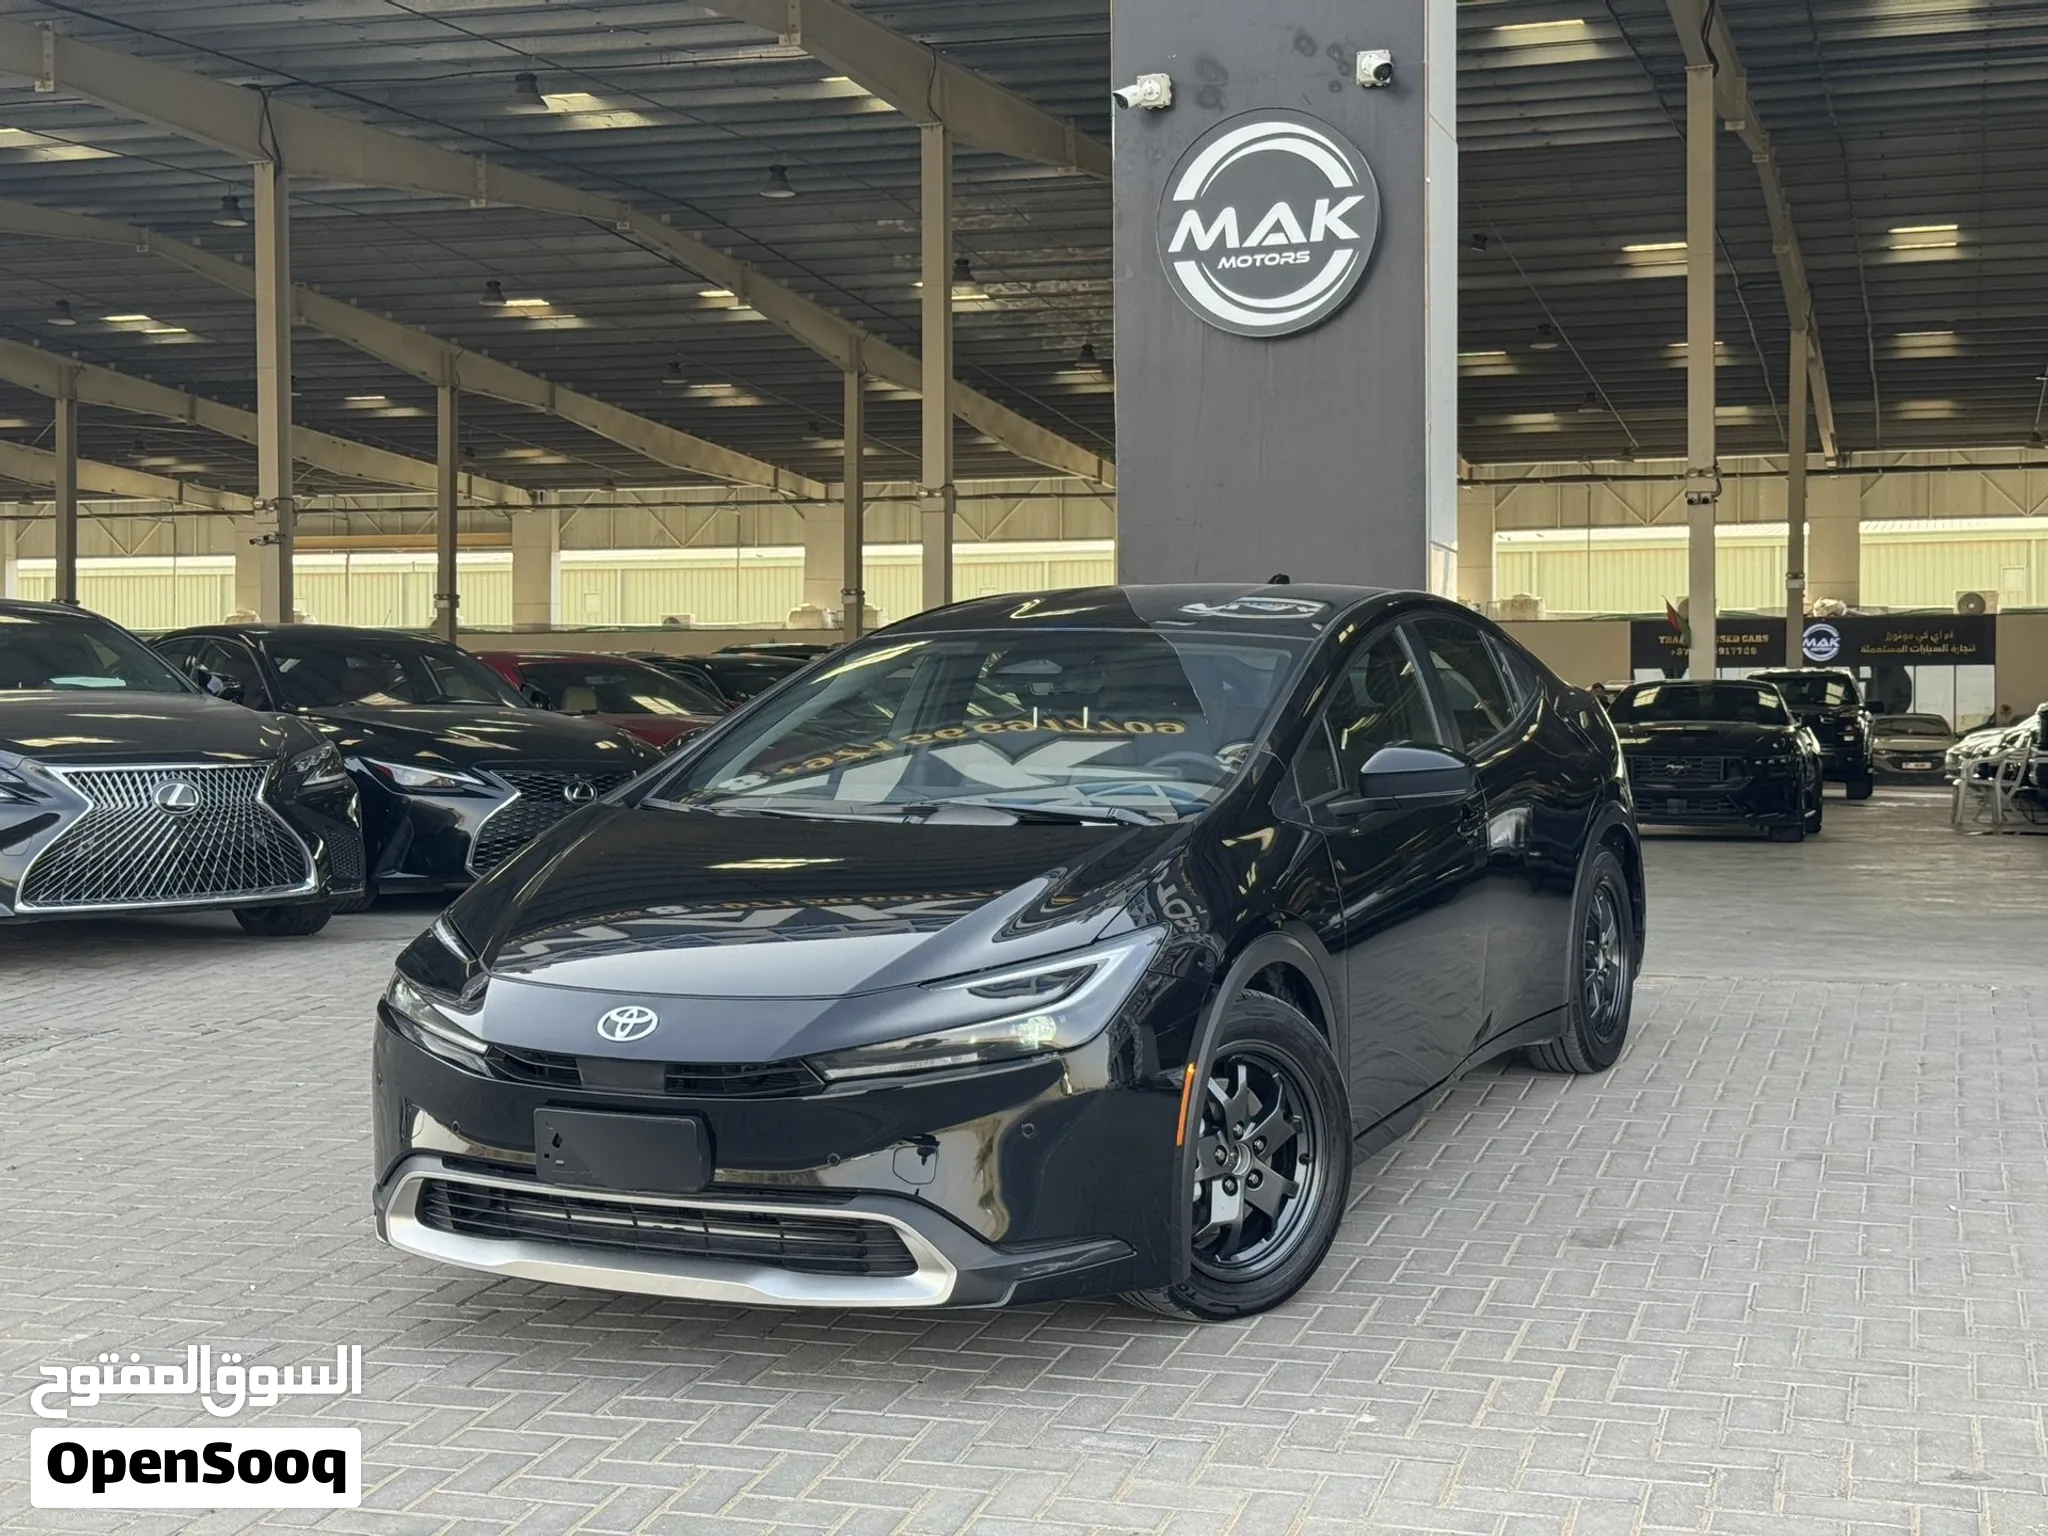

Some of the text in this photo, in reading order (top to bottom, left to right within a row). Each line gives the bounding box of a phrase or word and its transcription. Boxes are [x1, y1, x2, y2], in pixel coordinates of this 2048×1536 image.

[1167, 195, 1366, 253] MAK
[1217, 250, 1311, 269] MOTORS
[1741, 634, 1769, 643] CARS
[1802, 637, 1841, 648] MAK
[1861, 643, 1908, 653] المستعملة
[1910, 643, 1948, 655] السيارات
